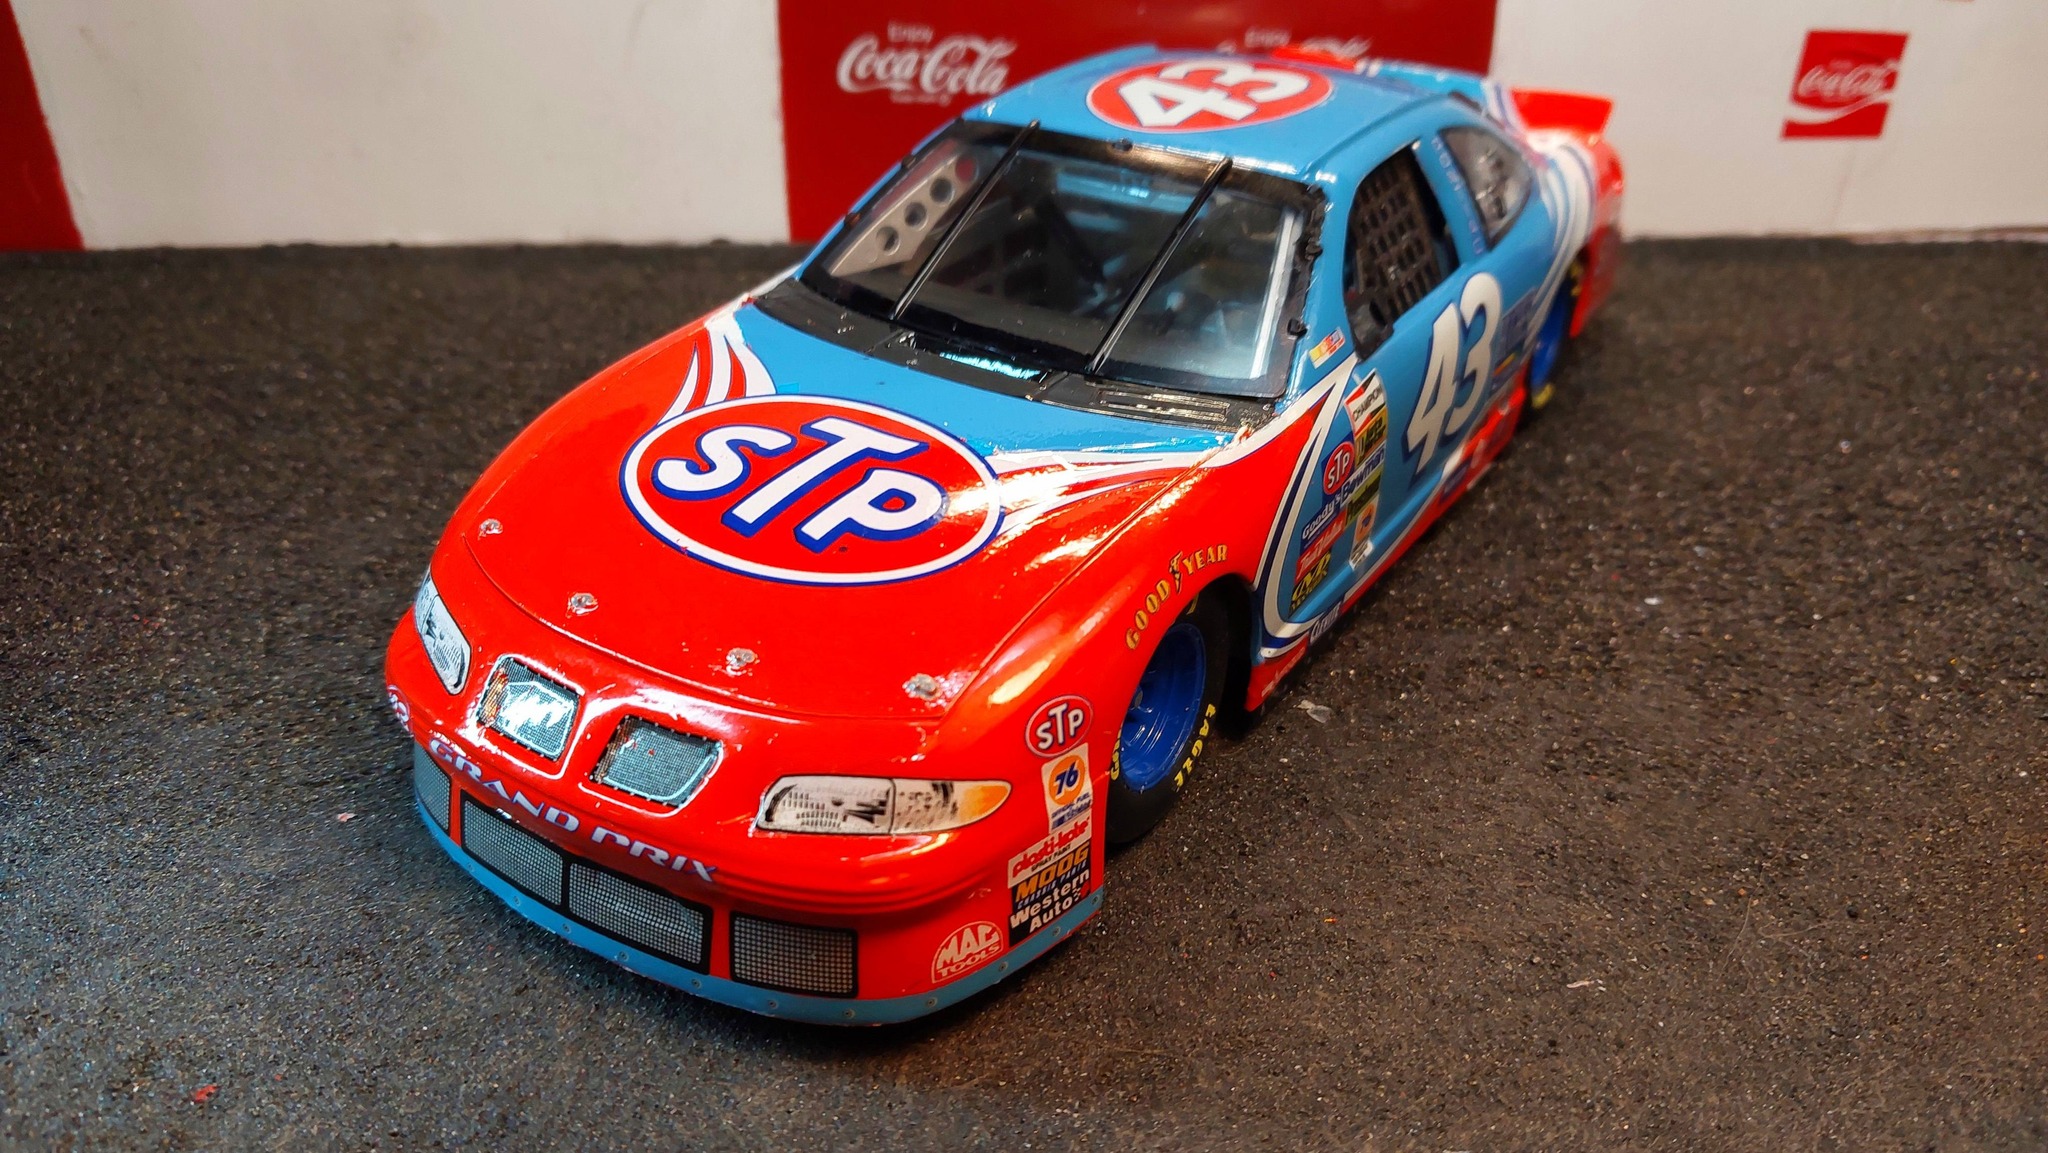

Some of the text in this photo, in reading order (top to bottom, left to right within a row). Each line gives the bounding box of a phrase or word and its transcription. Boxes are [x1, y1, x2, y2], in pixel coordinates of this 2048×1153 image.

[836, 32, 1018, 95] Coca-Cola
[1117, 60, 1309, 128] 43
[1406, 271, 1502, 477] 43
[652, 415, 949, 553] STP
[1327, 449, 1351, 489] STP
[1302, 494, 1341, 540] Goody's
[1035, 702, 1085, 751] STP
[1054, 760, 1080, 799] 76
[429, 736, 718, 883] GRAND PRIX
[1012, 819, 1090, 878] plasti-kote
[1016, 840, 1090, 903] MOOG
[1010, 868, 1091, 929] Western
[1018, 859, 1088, 910] CHASSIS PARTS
[1030, 895, 1074, 934] Auto
[936, 924, 1001, 971] MAC
[937, 943, 1001, 977] TOOLS
